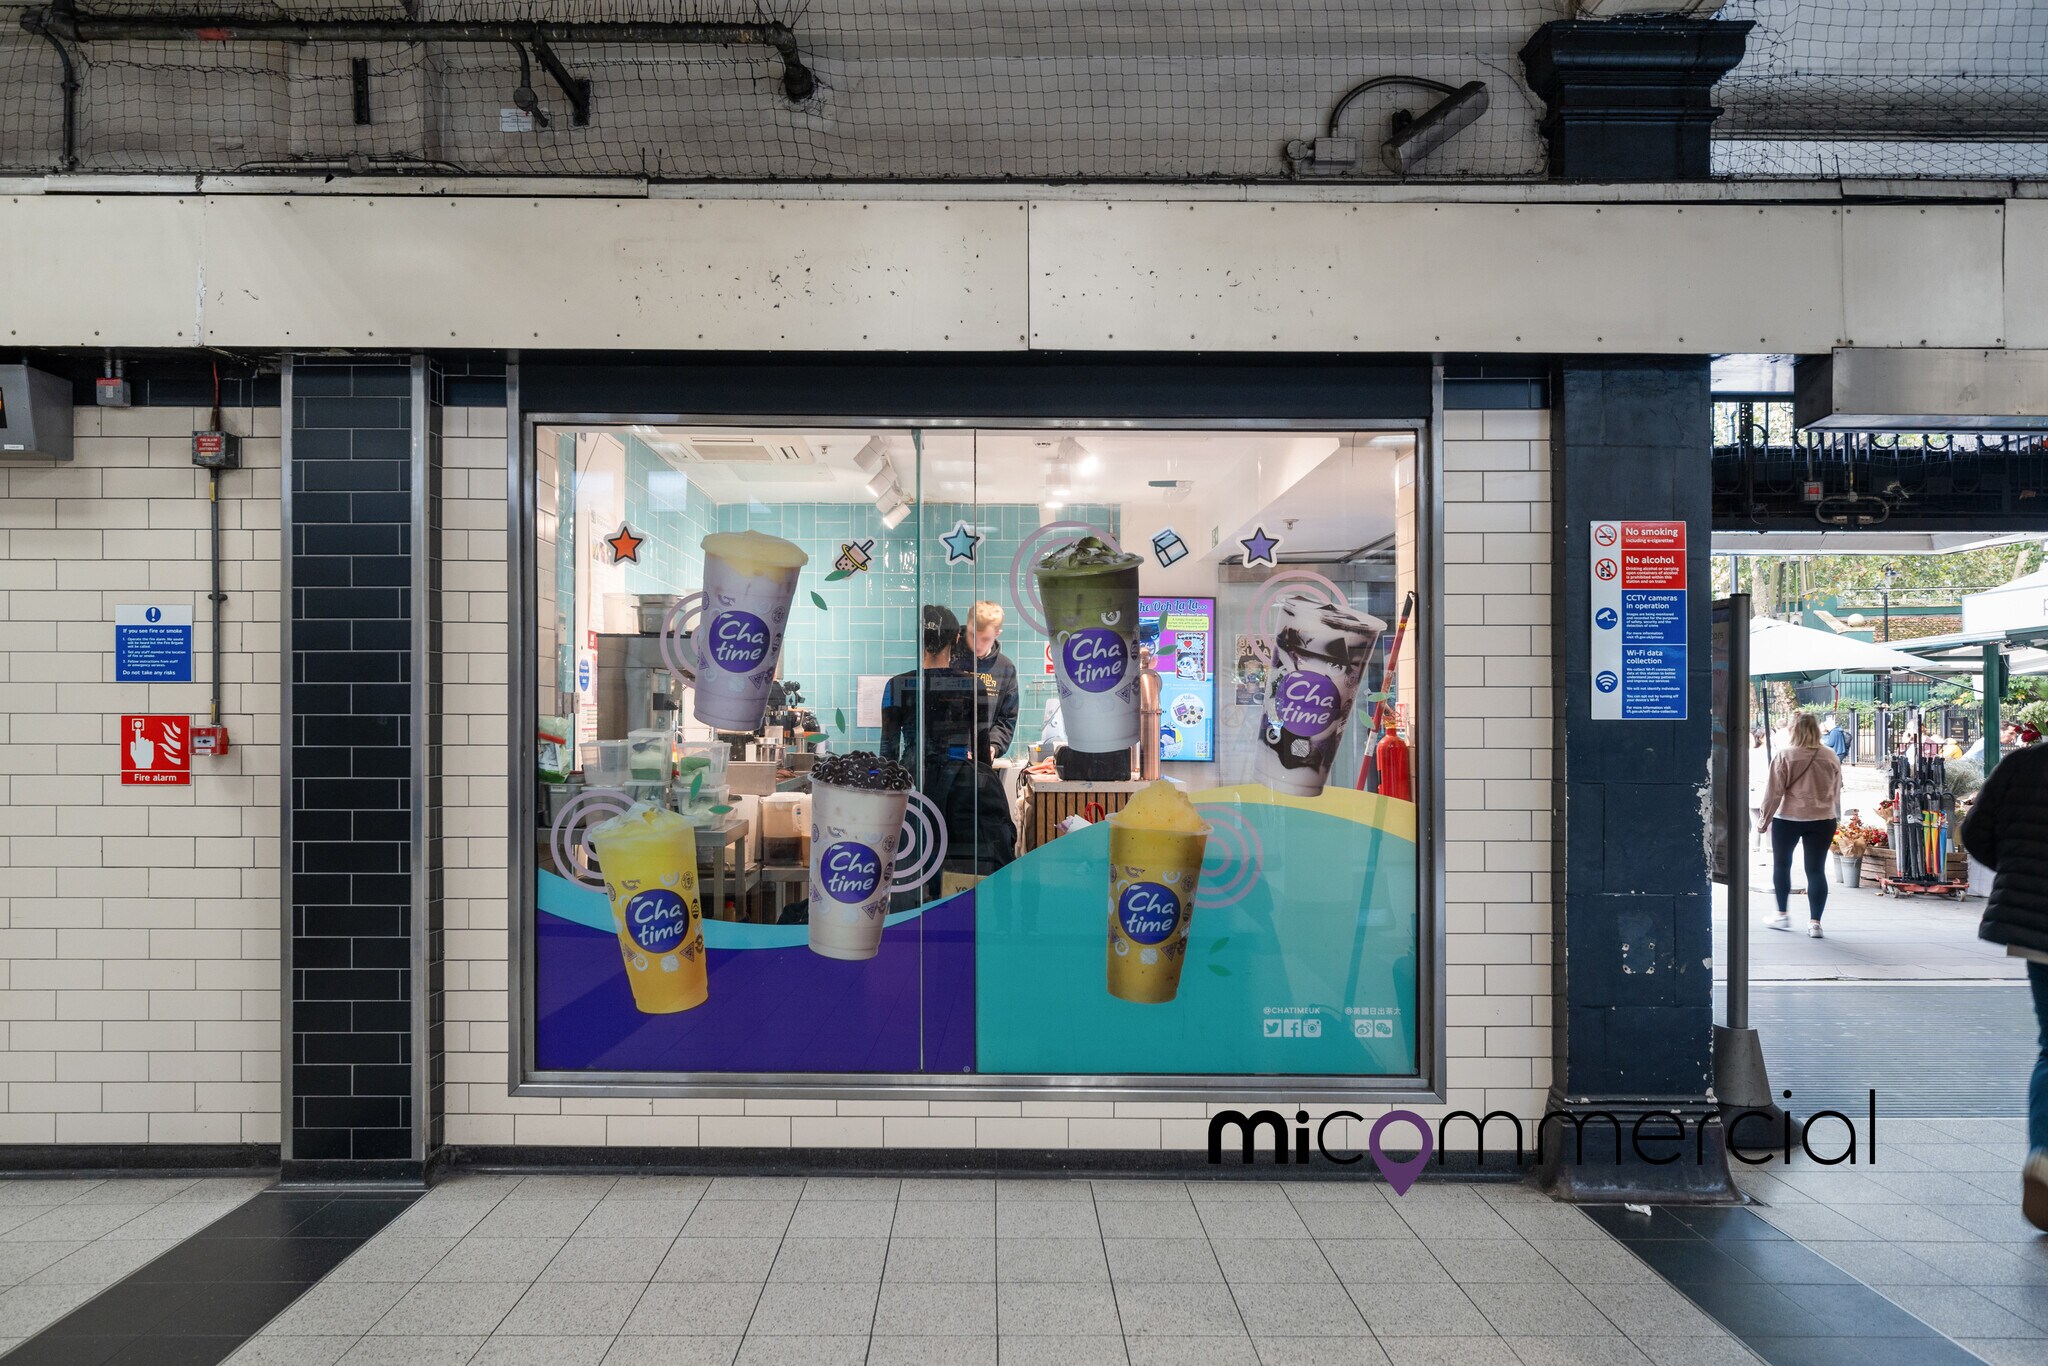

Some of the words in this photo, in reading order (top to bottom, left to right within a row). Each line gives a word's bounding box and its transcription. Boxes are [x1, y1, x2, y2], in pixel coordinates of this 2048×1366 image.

[1626, 528, 1639, 536] No
[1641, 528, 1678, 537] smoking
[1642, 556, 1674, 564] alcohol
[718, 620, 764, 644] Cha
[716, 641, 762, 661] time
[1072, 637, 1122, 662] Cha
[1074, 661, 1122, 684] time
[1286, 680, 1334, 709] Cha
[1281, 701, 1331, 724] time
[829, 851, 876, 874] Cha
[828, 872, 874, 892] time
[634, 899, 683, 924] Cha
[1127, 891, 1174, 915] Cha
[638, 920, 684, 946] time
[1126, 913, 1173, 933] time
[1263, 1006, 1320, 1014] @CHATIMEUK
